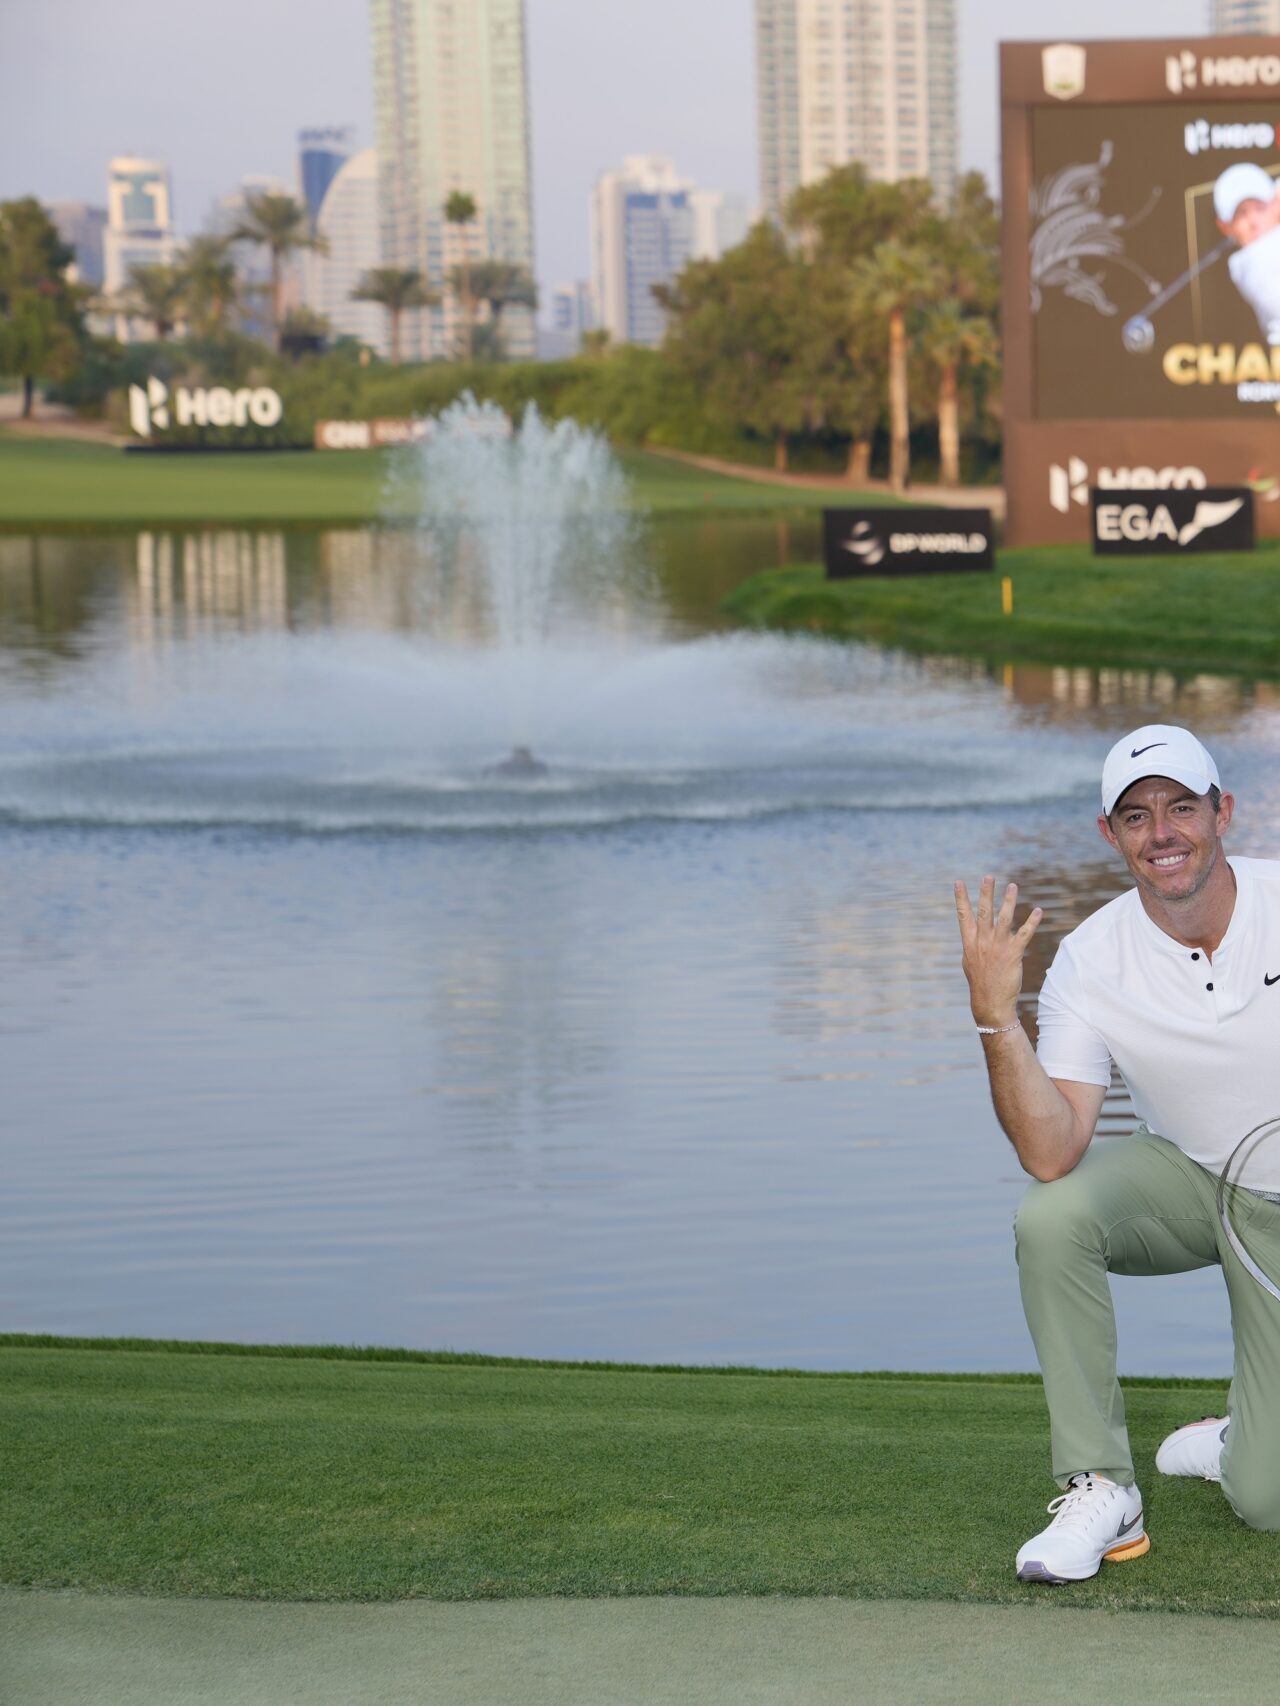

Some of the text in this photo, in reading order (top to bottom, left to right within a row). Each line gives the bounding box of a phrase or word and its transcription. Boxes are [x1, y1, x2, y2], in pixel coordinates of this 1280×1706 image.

[175, 386, 283, 427] Hero
[1096, 503, 1178, 541] EGA
[889, 532, 988, 554] DP WORLD
